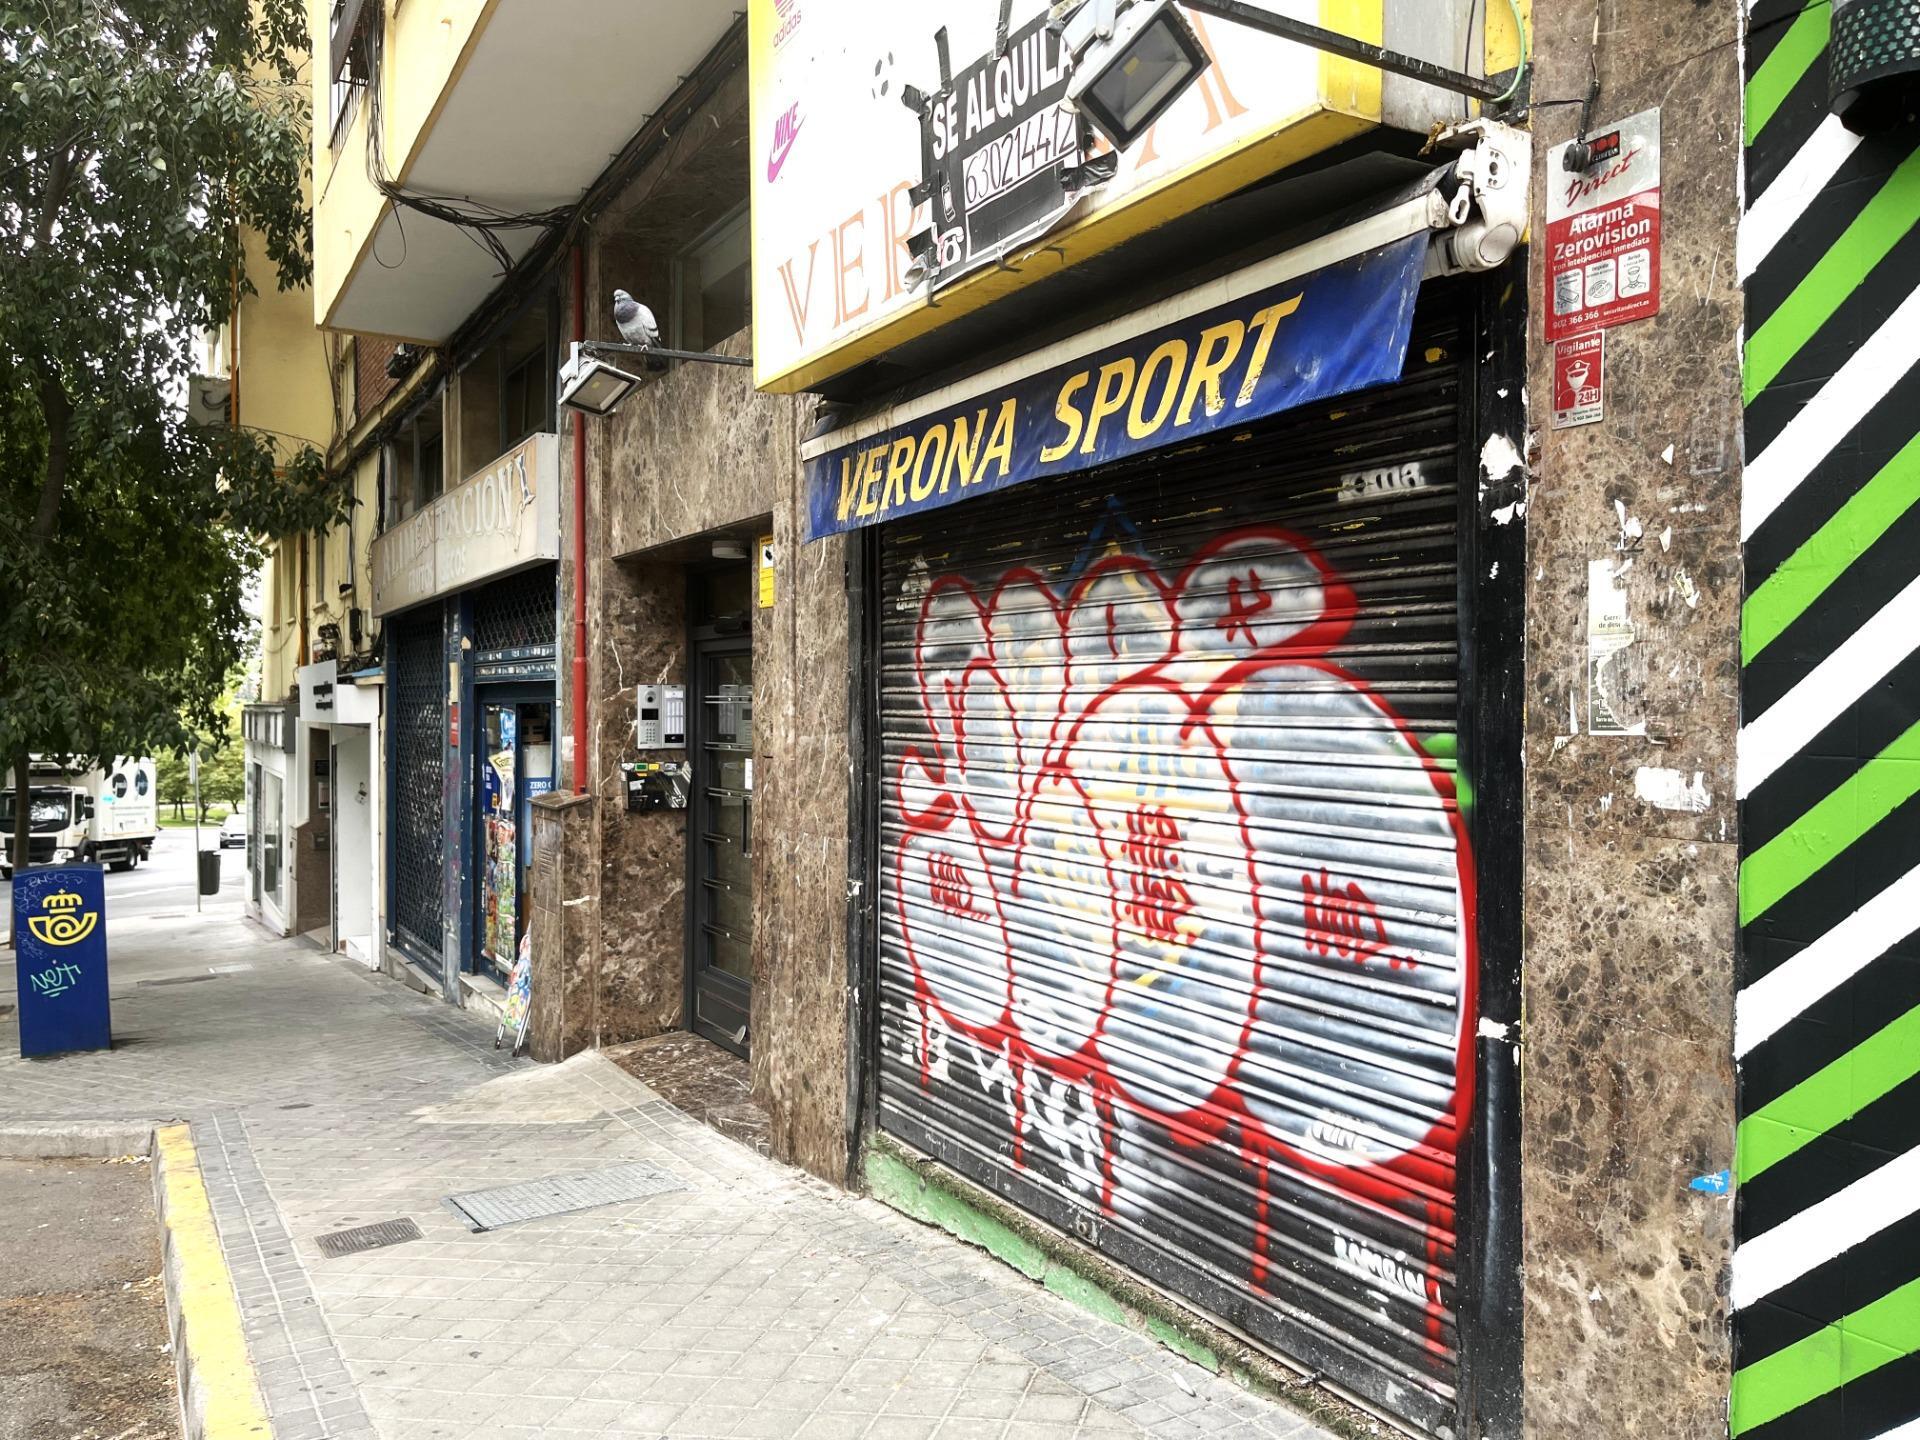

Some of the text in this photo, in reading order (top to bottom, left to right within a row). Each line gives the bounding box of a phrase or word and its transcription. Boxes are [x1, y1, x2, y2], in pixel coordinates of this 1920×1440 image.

[773, 9, 801, 48] adidas
[932, 26, 1074, 160] SE ALQUILA
[773, 101, 799, 154] NIKE
[965, 104, 1076, 202] 630214412
[1565, 148, 1641, 208] Direct
[1569, 203, 1635, 236] Alarma
[1553, 219, 1651, 261] Zerovision
[1613, 237, 1651, 254] inmediata
[1569, 314, 1583, 325] 366
[1585, 310, 1599, 322] 366
[1557, 338, 1601, 356] Vigilante
[837, 292, 1304, 522] VERONA SPORT
[1579, 388, 1599, 403] 24H
